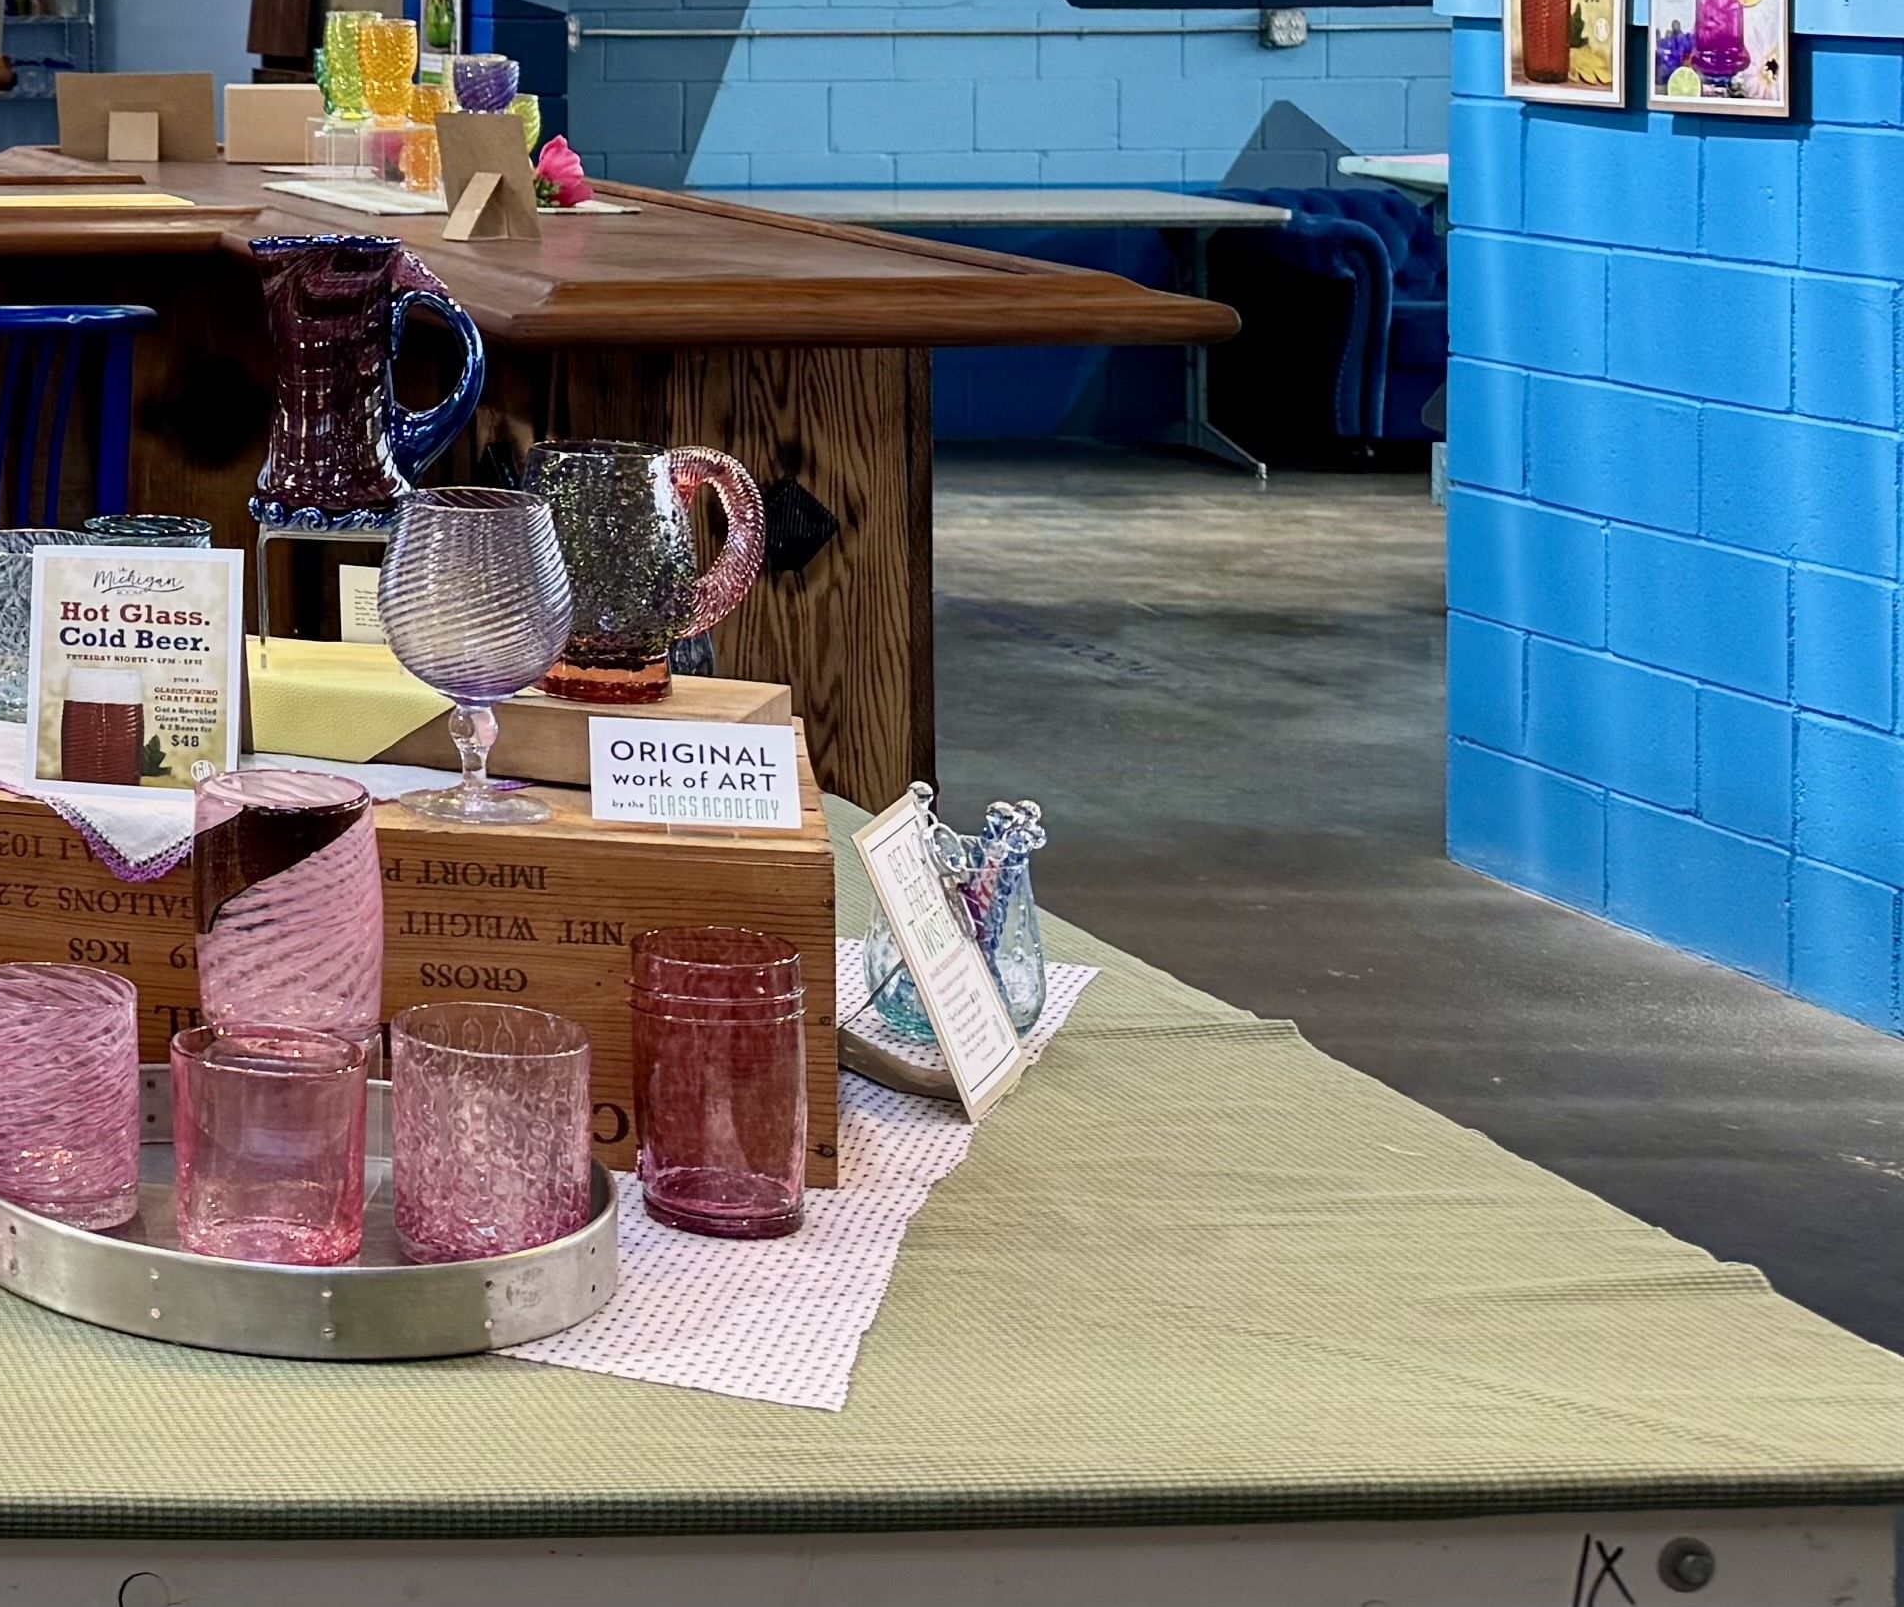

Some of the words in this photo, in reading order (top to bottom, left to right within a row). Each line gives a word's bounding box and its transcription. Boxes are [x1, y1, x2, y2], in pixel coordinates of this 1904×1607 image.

[94, 570, 181, 592] Michigan
[60, 602, 110, 622] Hot
[120, 604, 210, 626] Glass.
[60, 627, 126, 647] Cold
[135, 630, 210, 651] Beer.
[171, 735, 199, 747] $48
[610, 740, 776, 767] ORIGINAL
[613, 769, 672, 788] work
[683, 771, 708, 789] of
[719, 773, 776, 791] ART
[612, 800, 623, 808] by
[649, 794, 697, 817] GLASS
[703, 797, 779, 820] ACADEMY
[418, 860, 548, 890] IMPORT
[400, 910, 537, 941] WEIGHT
[558, 921, 626, 947] NET
[69, 938, 130, 964] KGS
[420, 962, 528, 993] GROSS
